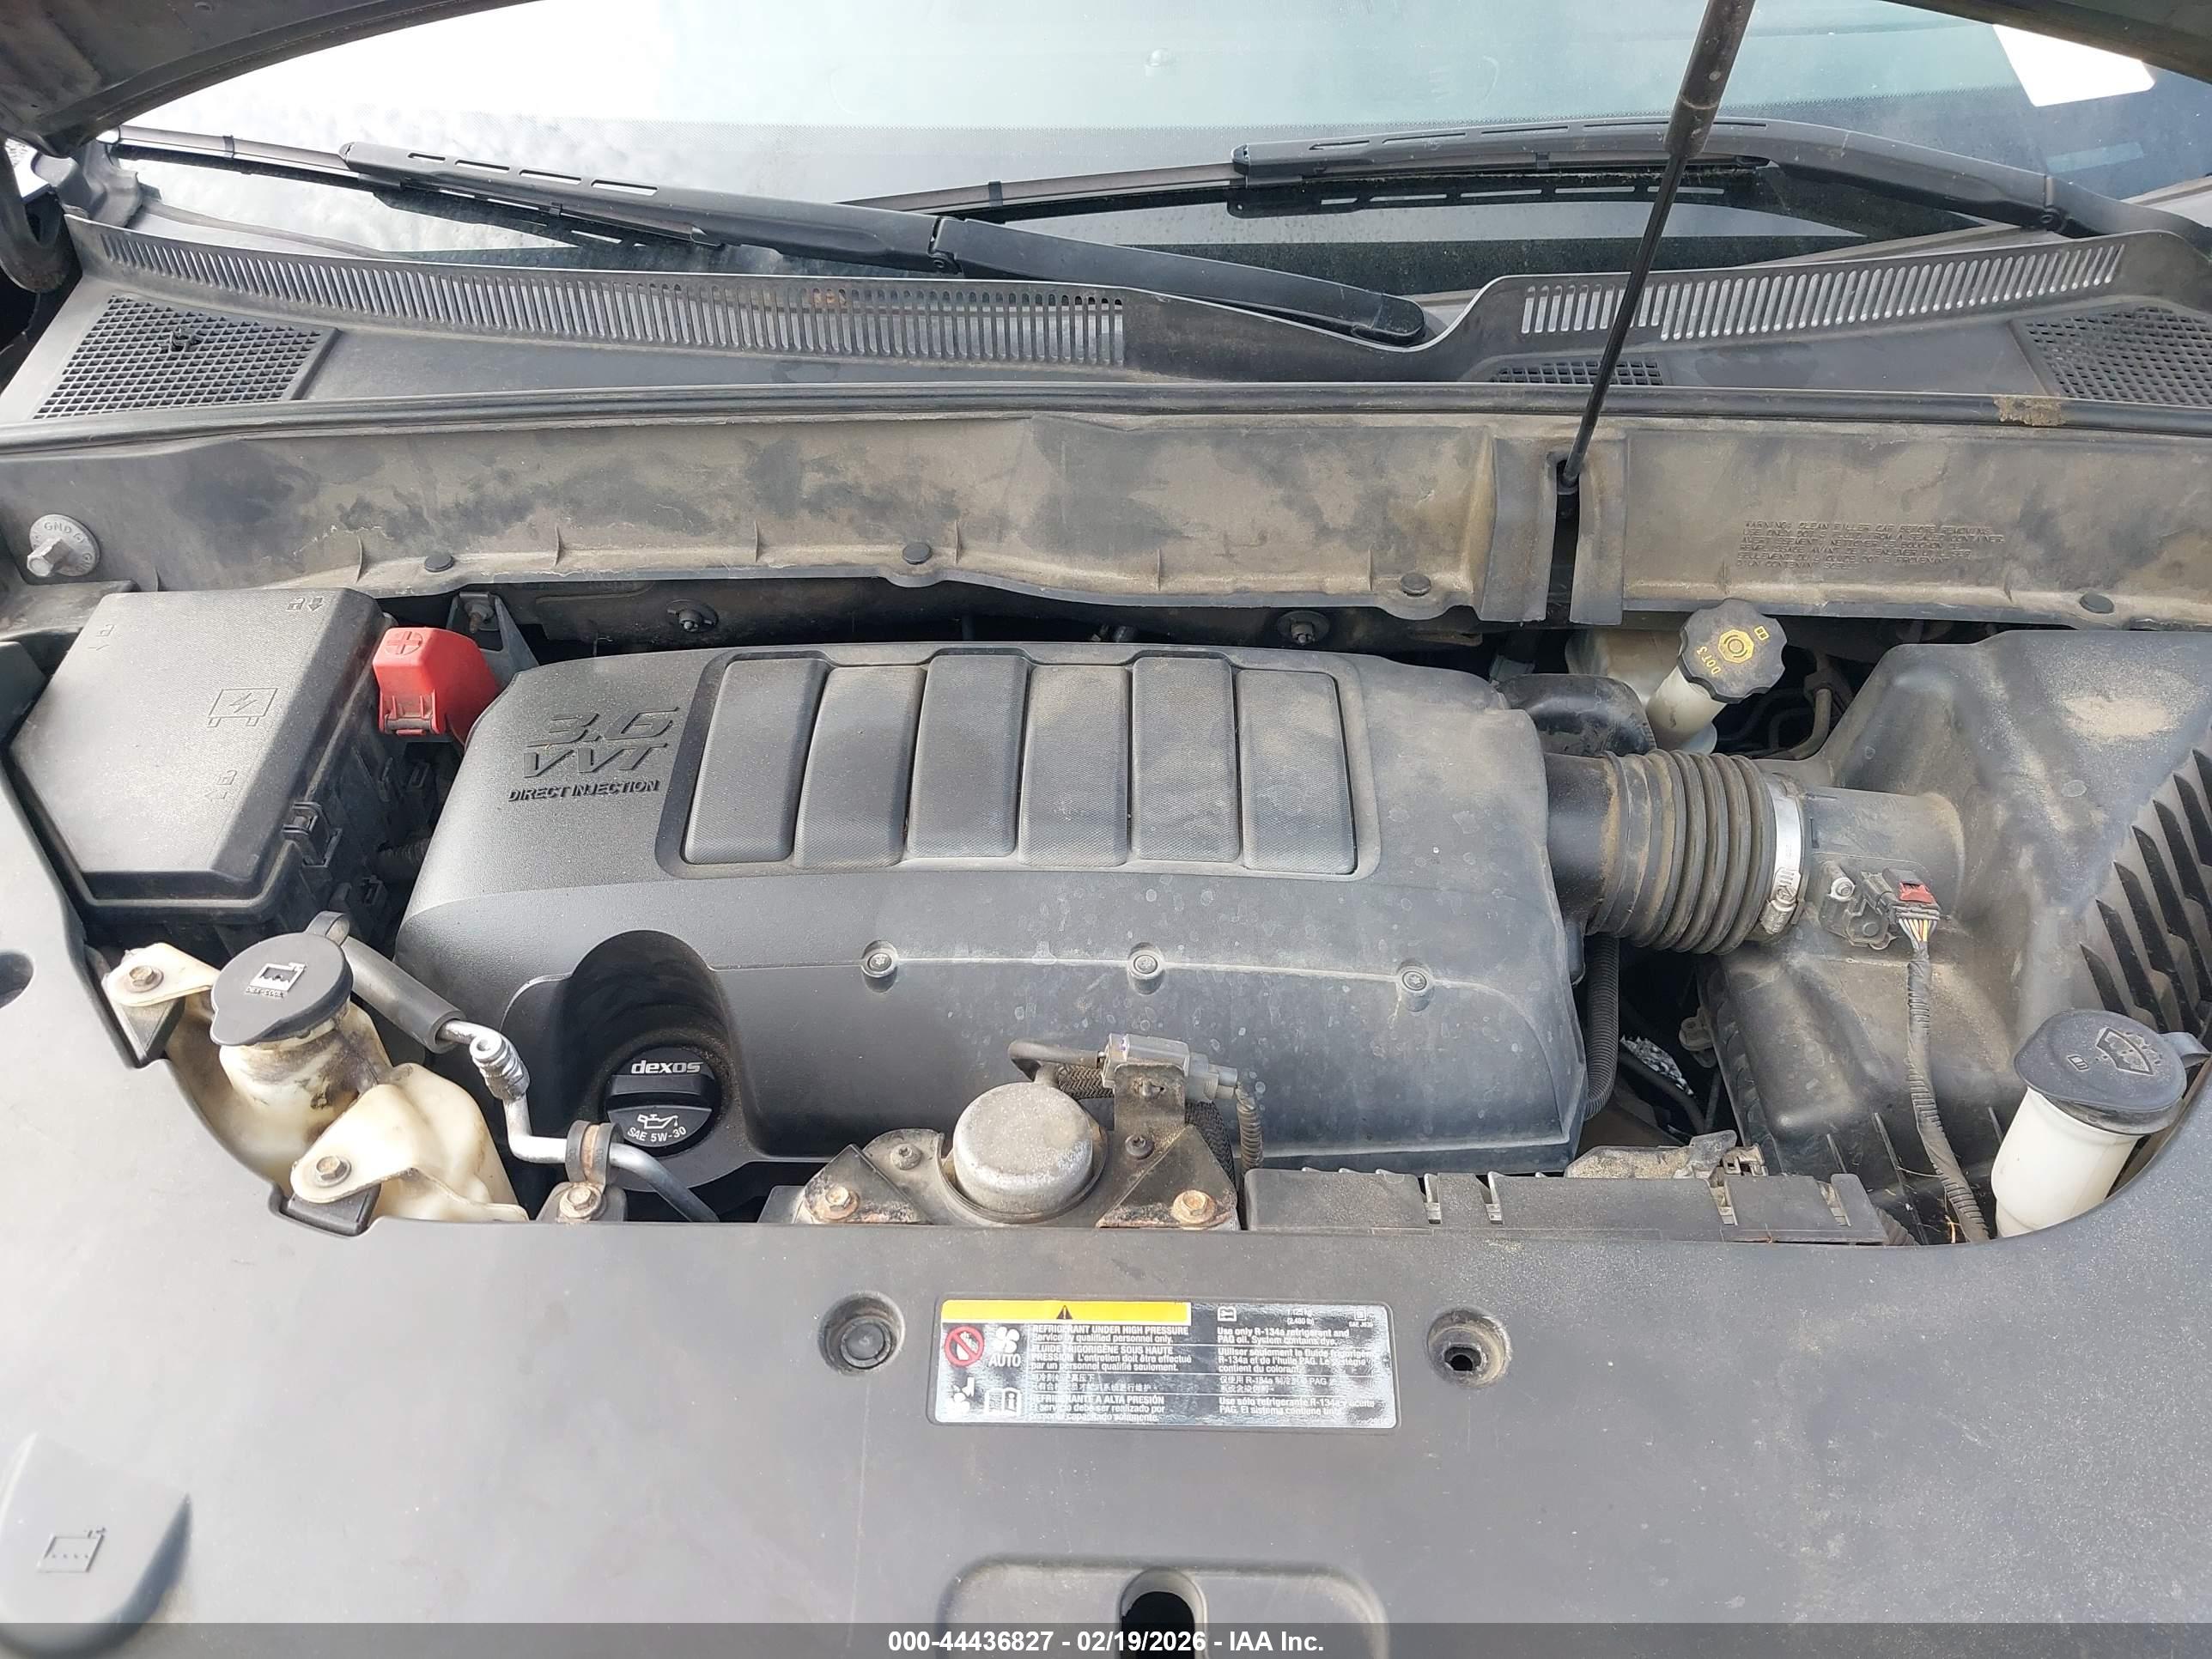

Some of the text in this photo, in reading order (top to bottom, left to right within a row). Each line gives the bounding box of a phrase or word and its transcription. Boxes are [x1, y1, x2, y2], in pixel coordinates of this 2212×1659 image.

[44, 521, 72, 533] GND
[526, 707, 680, 748] 3.6
[523, 744, 668, 779] VVT
[508, 779, 659, 802] DIRECT INJECTION
[631, 1060, 704, 1074] dexos
[627, 1126, 687, 1142] SAE 5W-30
[1091, 1325, 1121, 1334] UNDER
[1121, 1325, 1143, 1334] HIGH
[1144, 1326, 1189, 1335] PRESSURE
[1217, 1327, 1350, 1339] Use only R-134a refrigerant and
[1076, 1333, 1111, 1343] qualified
[1113, 1334, 1153, 1344] personnel
[1154, 1334, 1174, 1346] only.
[1217, 1334, 1235, 1344] PAG
[1251, 1335, 1282, 1346] System
[1121, 1345, 1144, 1354] SOUS
[1145, 1346, 1174, 1355] HAUTE
[988, 1353, 1021, 1367] AUTO
[1121, 1353, 1139, 1363] doit
[1218, 1355, 1248, 1364] R-134a
[1260, 1356, 1271, 1364] de
[1218, 1364, 1252, 1372] contient
[1253, 1364, 1265, 1373] du
[1309, 1376, 1328, 1386] PAG
[1103, 1395, 1125, 1405] ALTA
[1127, 1394, 1165, 1405] PRESIÓN
[1151, 1406, 1166, 1415] por
